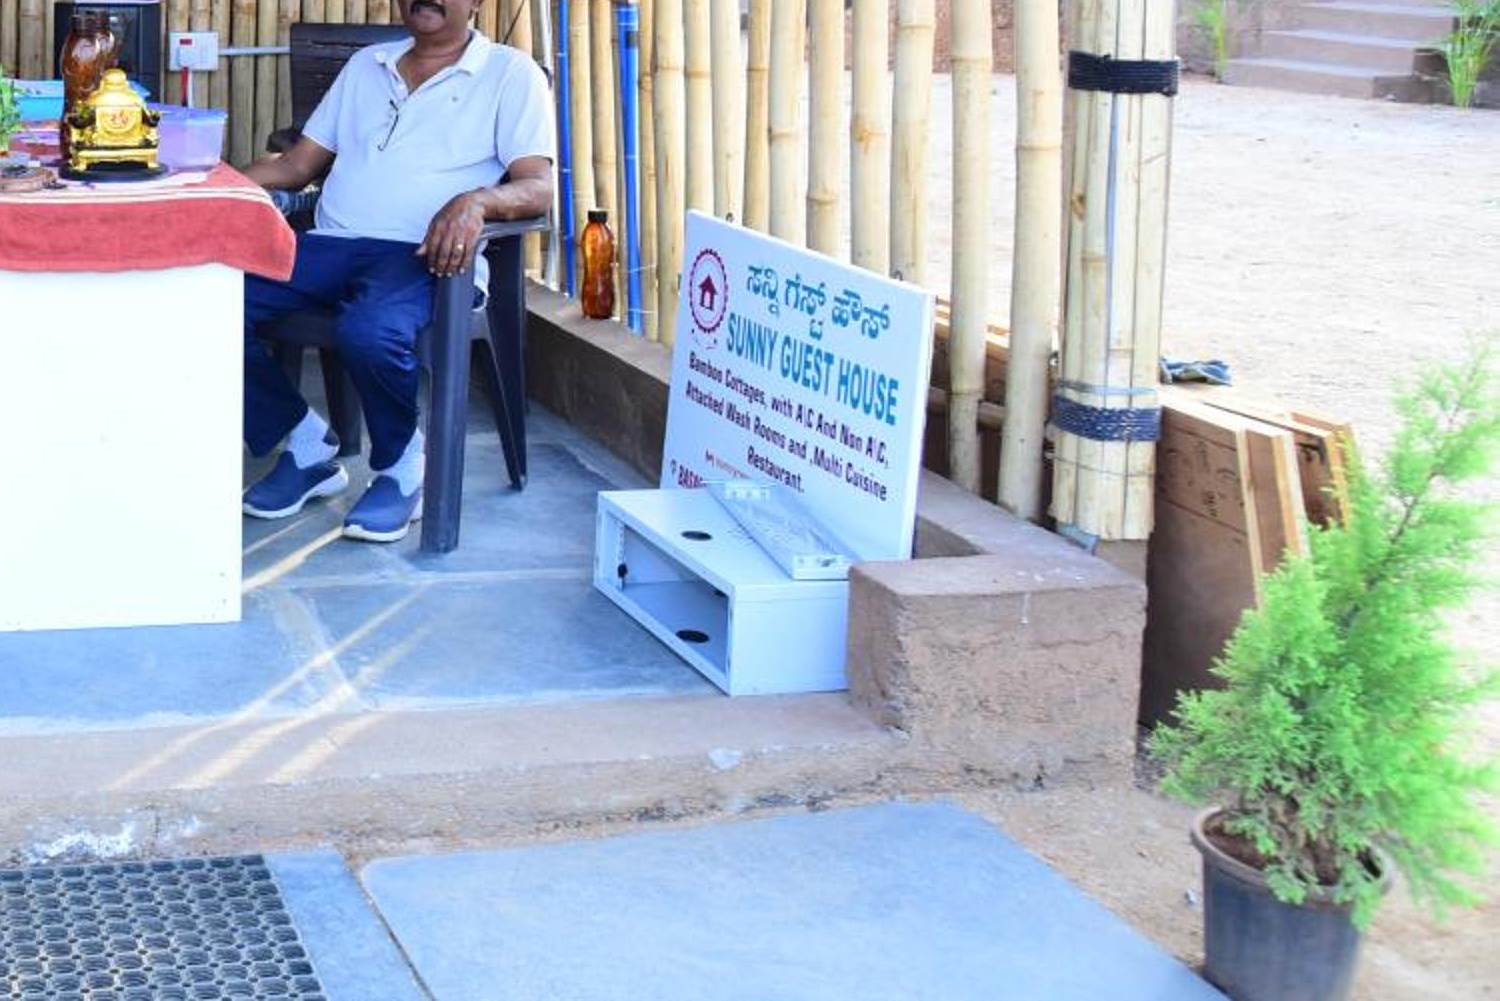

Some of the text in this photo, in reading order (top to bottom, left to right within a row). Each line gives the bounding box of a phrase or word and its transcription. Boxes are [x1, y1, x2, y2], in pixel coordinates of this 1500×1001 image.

[689, 350, 723, 383] Bamboo
[771, 394, 793, 419] with
[816, 413, 837, 440] And
[839, 423, 863, 451] Non
[726, 312, 899, 426] SUNNY GUEST HOUSE
[685, 380, 724, 416] Attached
[725, 403, 751, 431] Wash
[753, 416, 786, 449] Rooms
[788, 438, 807, 460] and
[845, 463, 888, 501] Cuisine
[747, 446, 805, 493] Restaurant.
